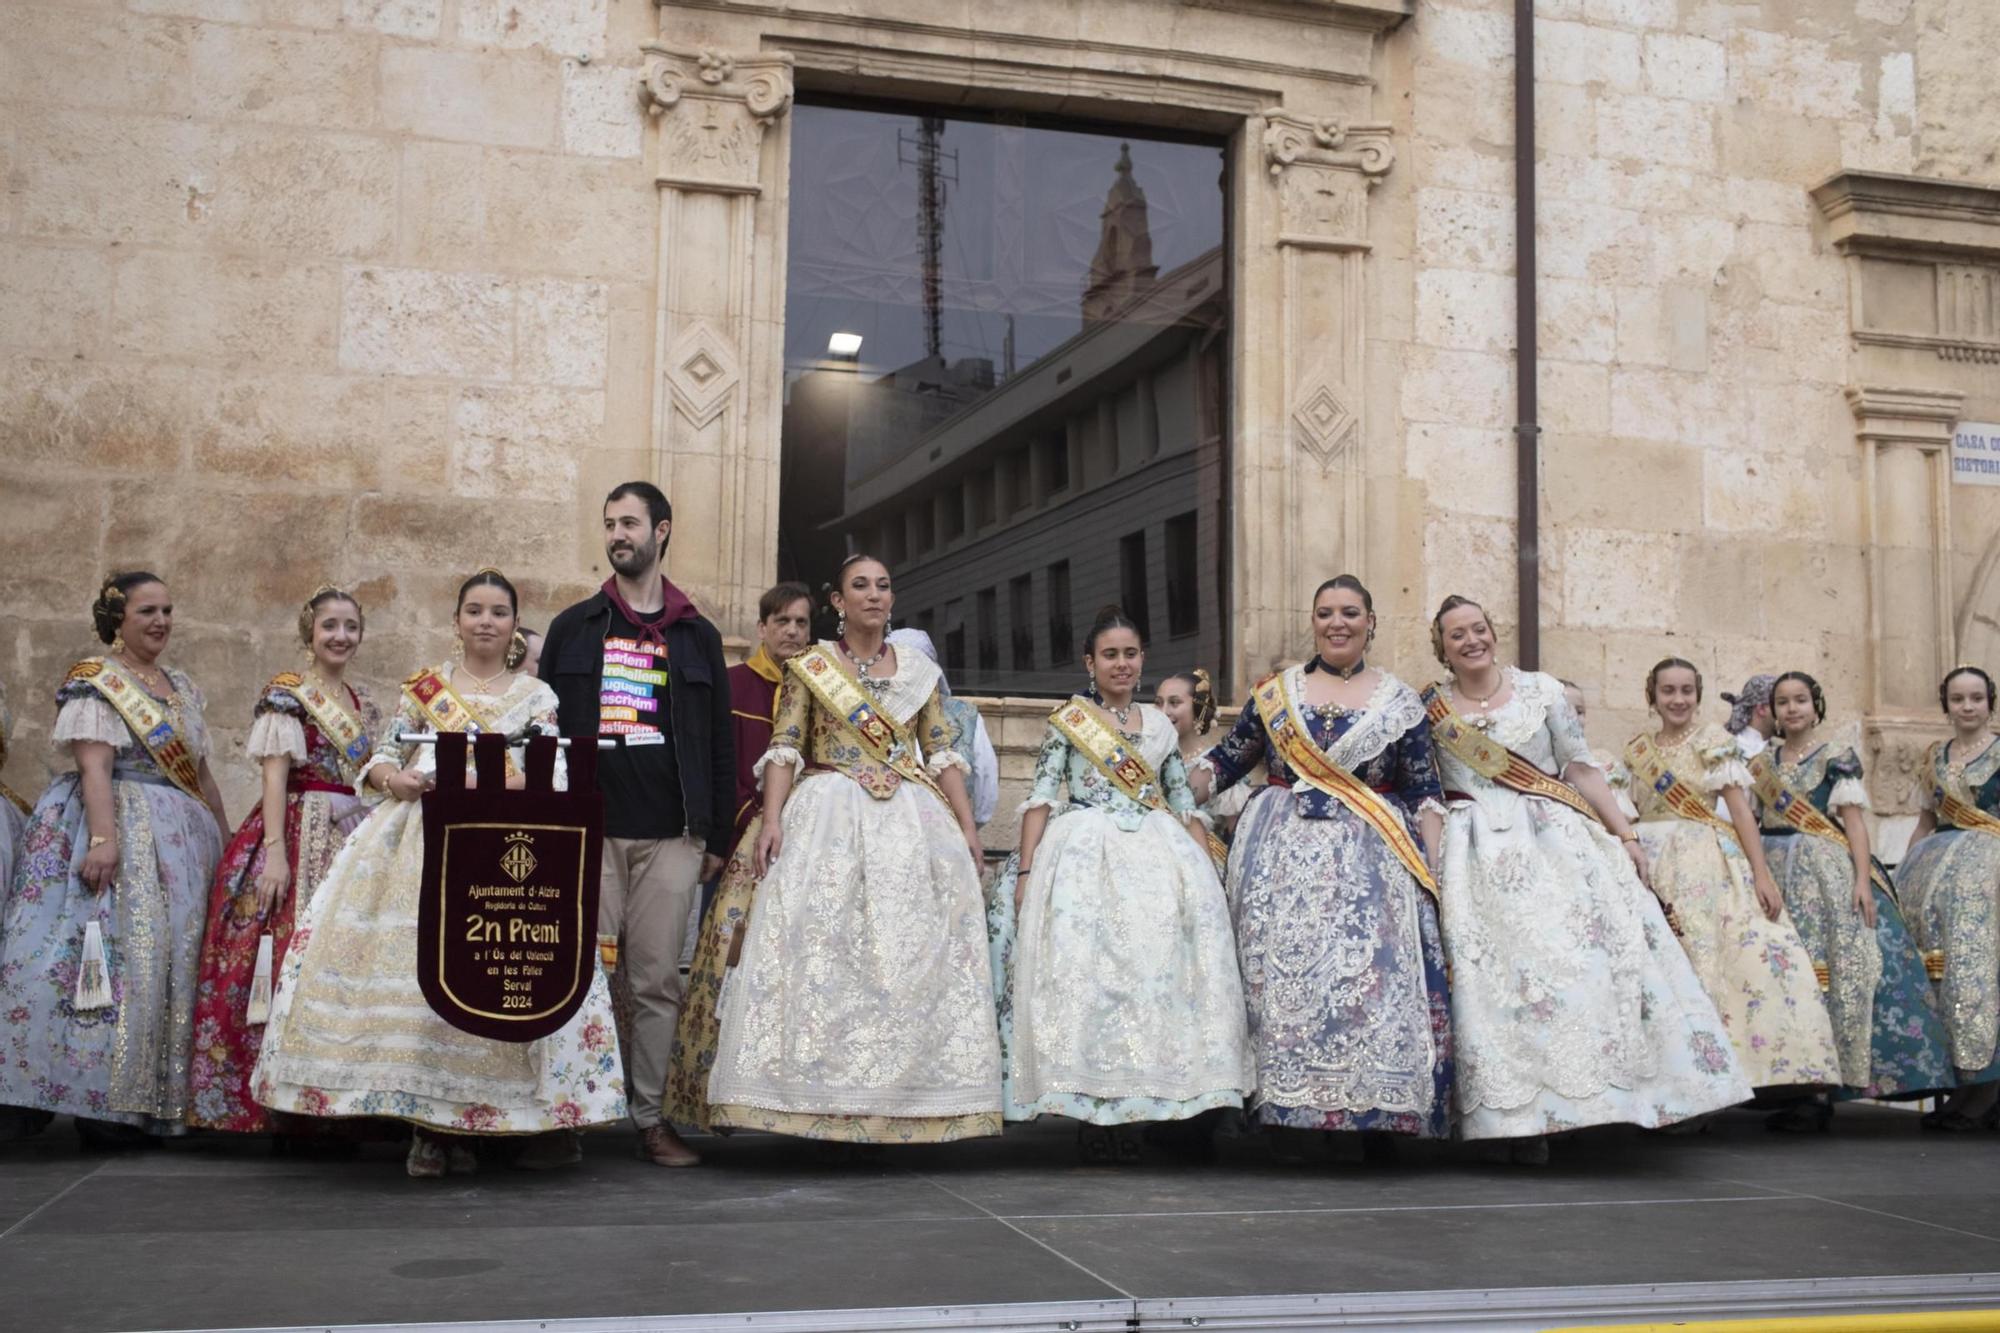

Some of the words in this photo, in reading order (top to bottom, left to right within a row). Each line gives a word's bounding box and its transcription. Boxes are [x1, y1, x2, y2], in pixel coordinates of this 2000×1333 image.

[1956, 433, 1986, 450] CASA
[604, 653, 648, 668] parlem
[603, 664, 662, 683] treballem
[602, 678, 648, 697] juguem
[601, 694, 653, 711] escrivim
[599, 722, 654, 735] estimem
[468, 885, 525, 899] Ajuntament
[466, 914, 501, 942] 2n
[509, 918, 560, 943] Premi
[474, 951, 480, 960] a
[509, 950, 522, 960] del
[487, 966, 499, 975] en
[504, 965, 518, 975] les
[522, 965, 543, 976] Falles
[503, 979, 532, 991] Serval
[502, 996, 533, 1008] 2024
